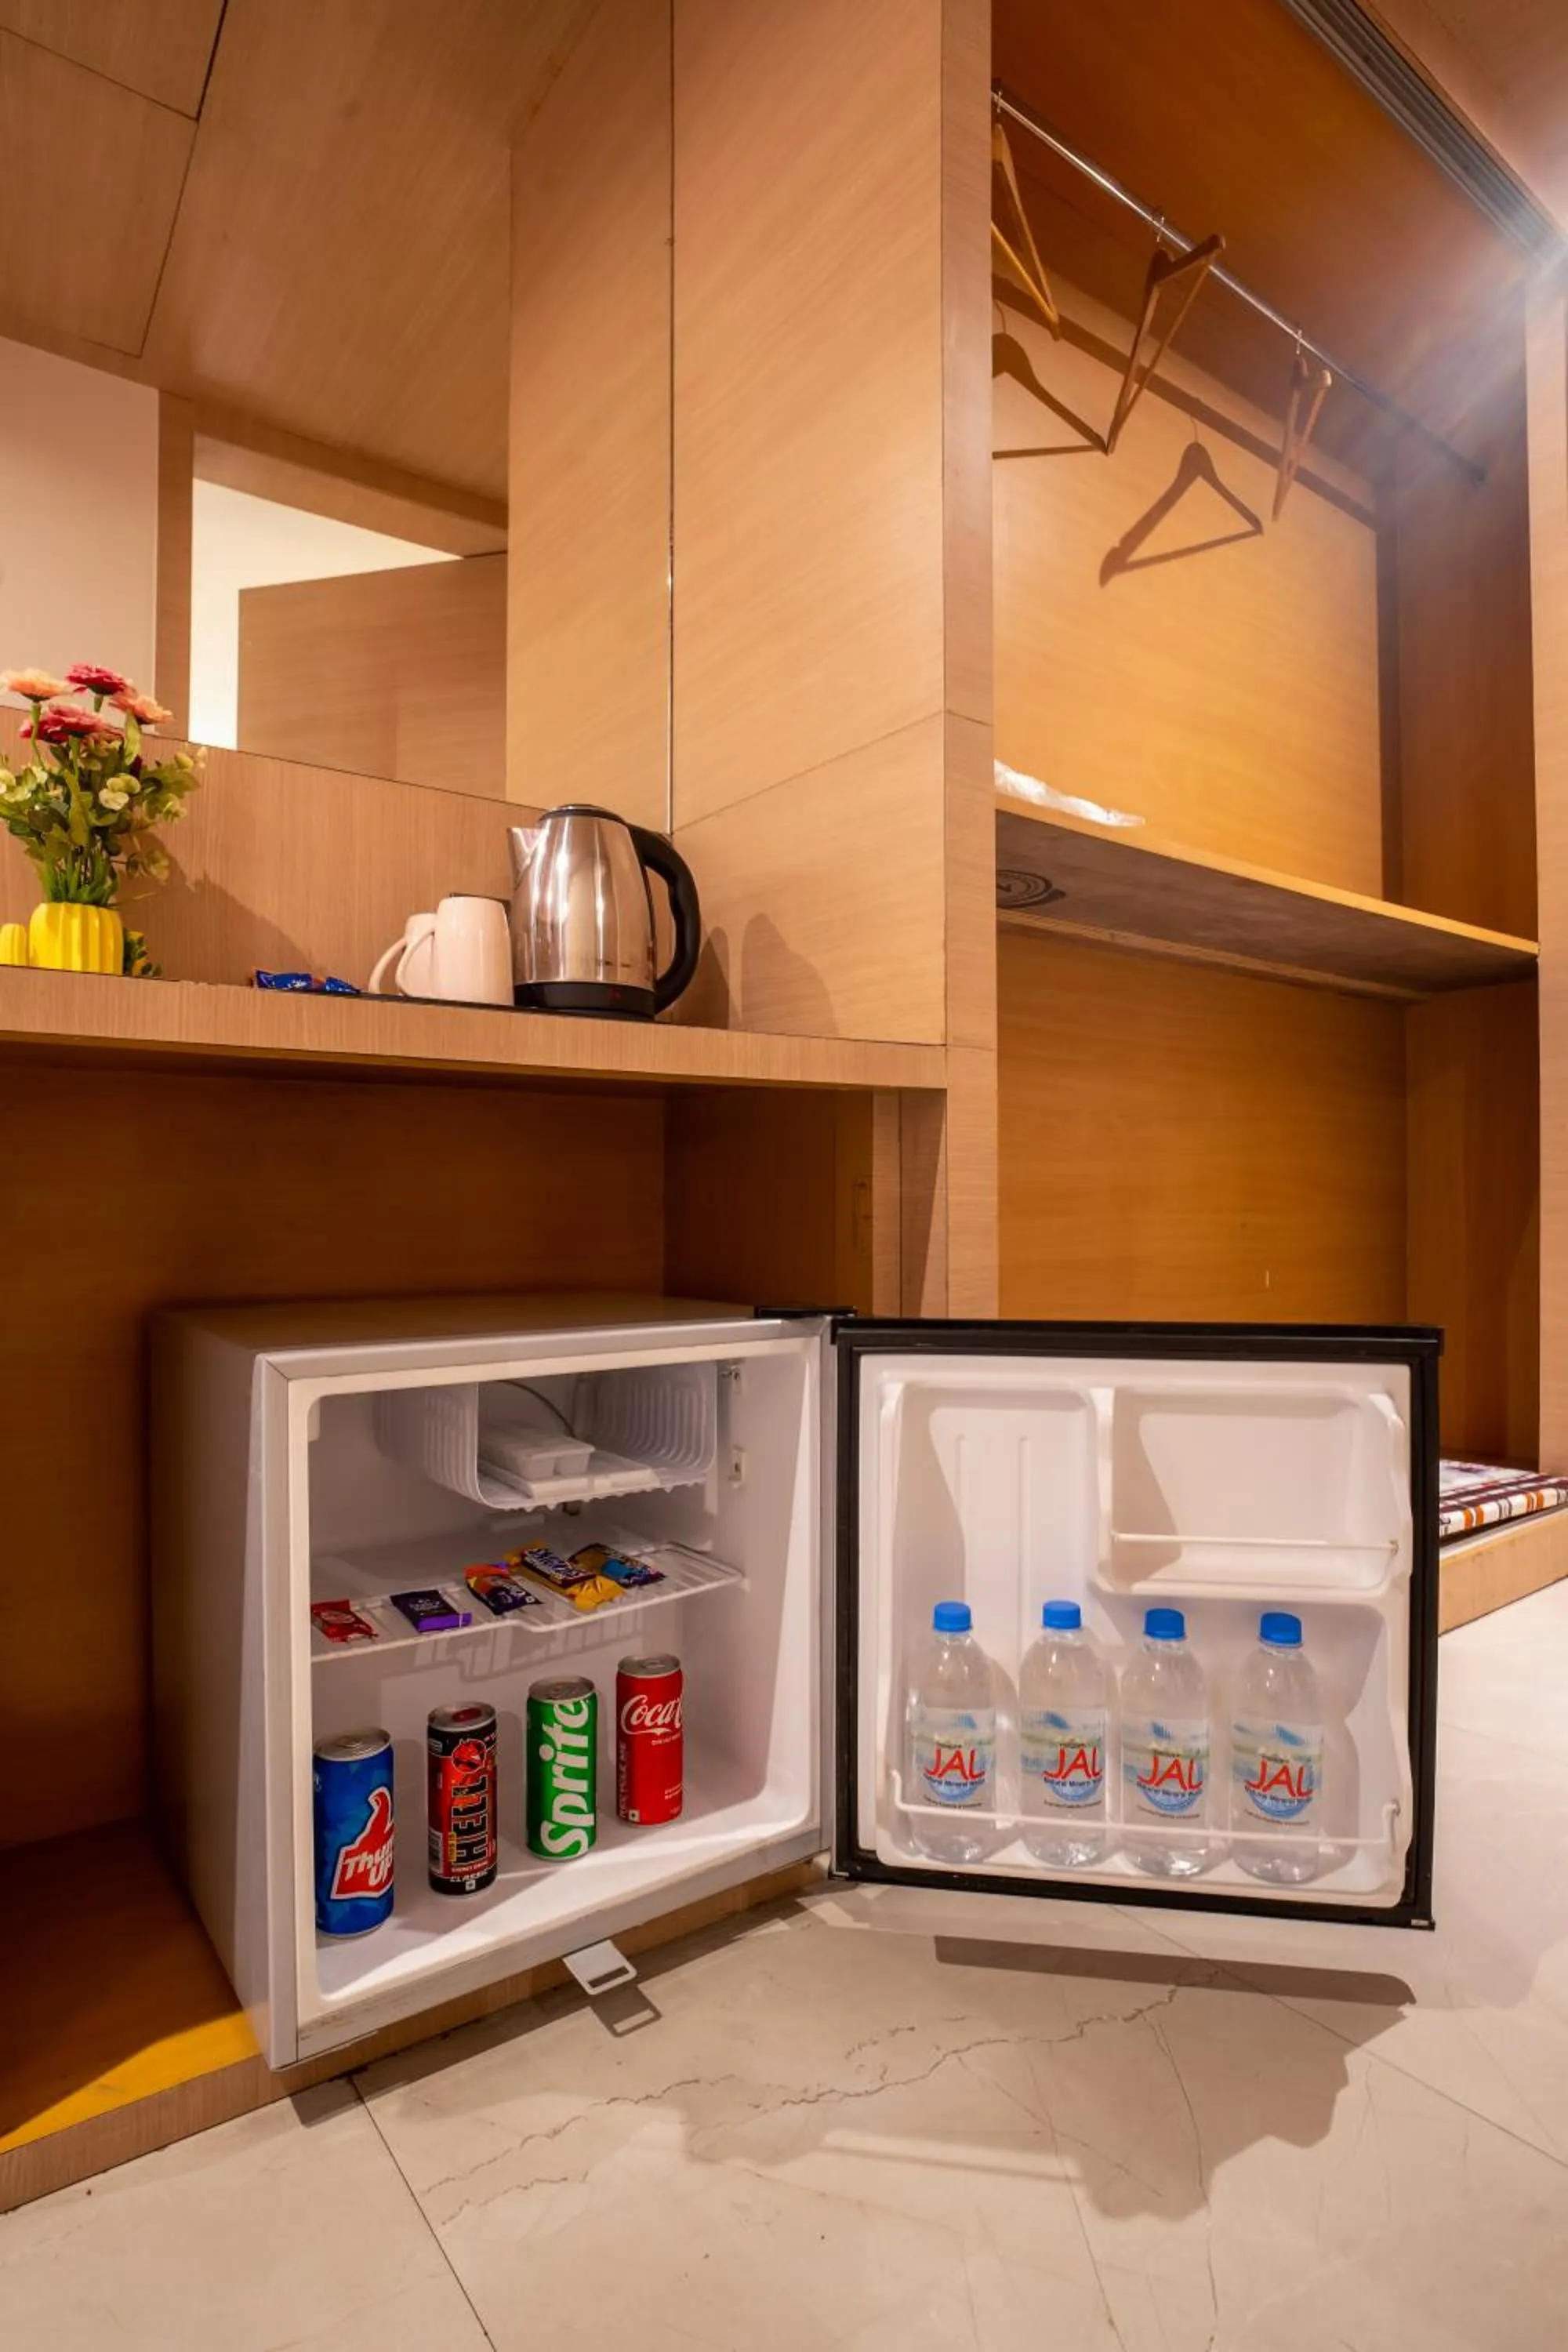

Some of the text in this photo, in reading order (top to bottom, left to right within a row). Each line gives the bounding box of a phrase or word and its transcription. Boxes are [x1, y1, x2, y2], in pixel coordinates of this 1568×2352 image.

[539, 1700, 594, 1857] Sprite
[924, 1746, 985, 1780] JAL
[1042, 1746, 1102, 1780] JAL
[1137, 1755, 1203, 1791] JAL
[1244, 1760, 1313, 1797] JAL
[451, 1774, 489, 1866] HELL
[343, 1835, 394, 1882] Thu
